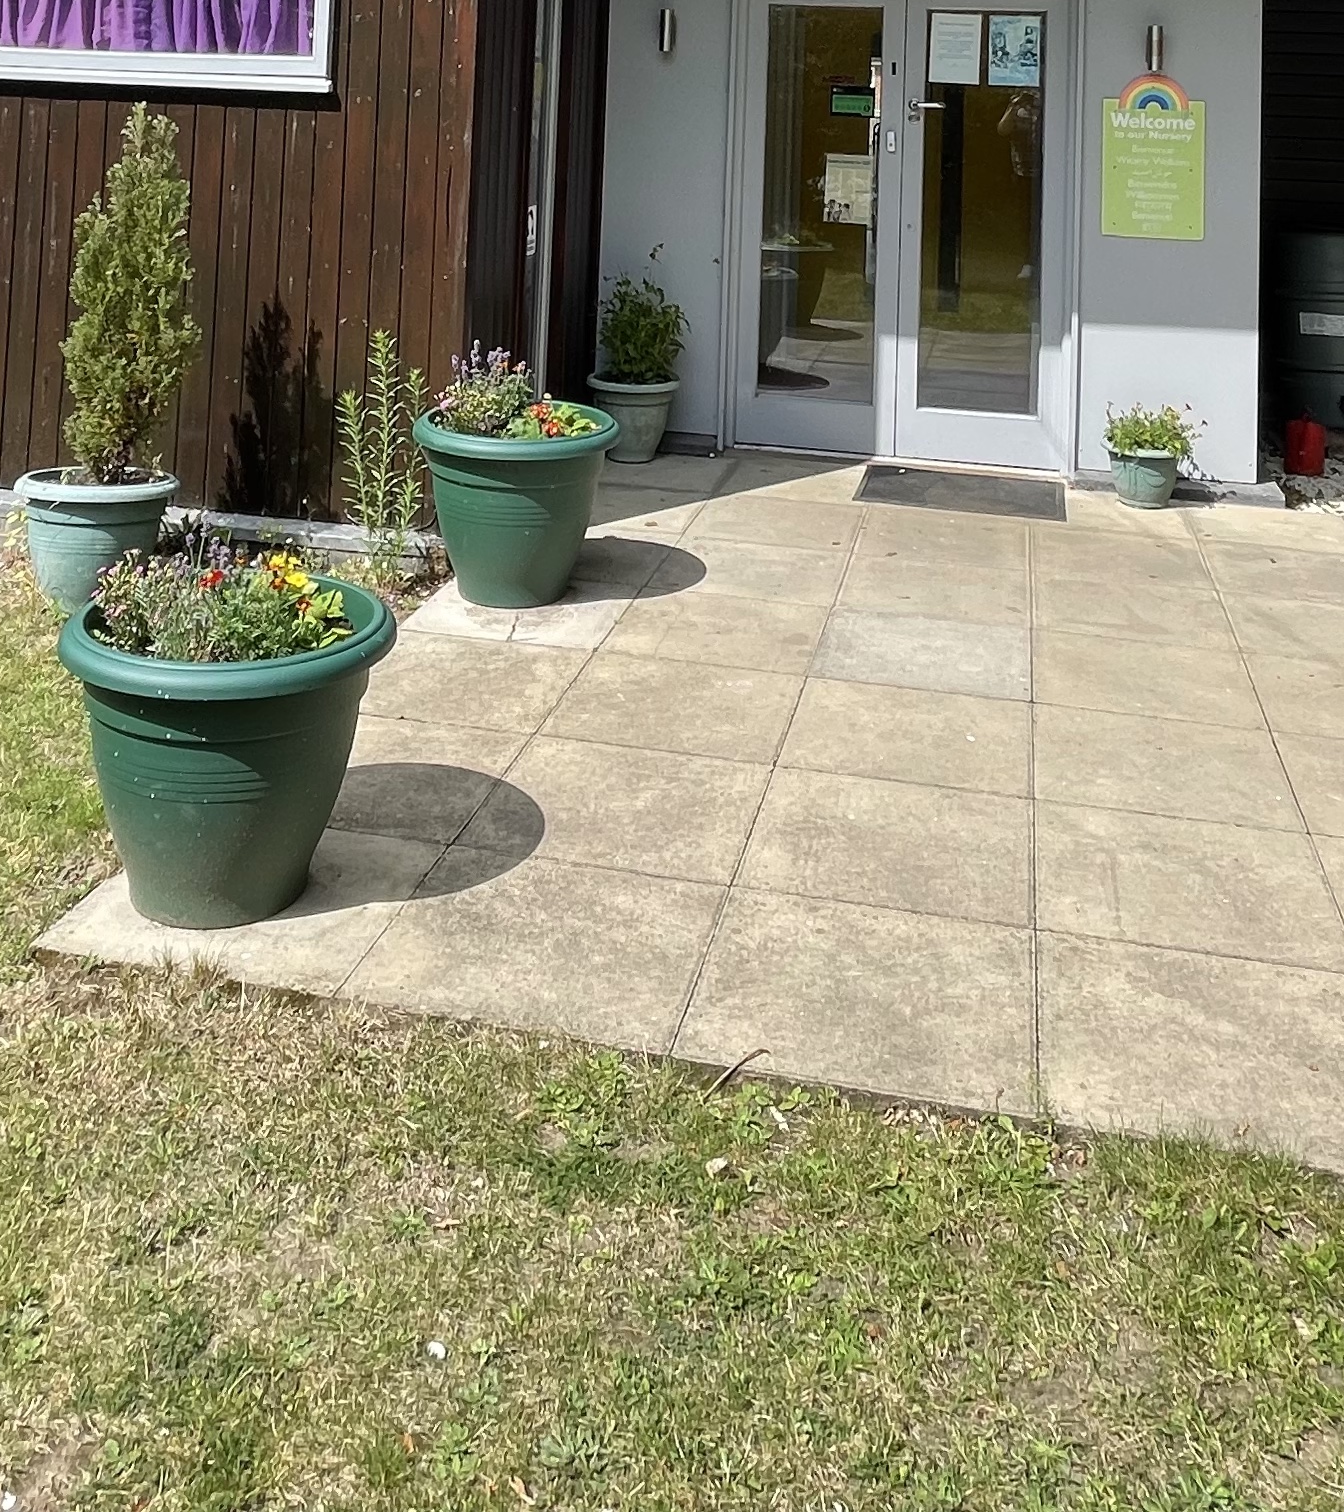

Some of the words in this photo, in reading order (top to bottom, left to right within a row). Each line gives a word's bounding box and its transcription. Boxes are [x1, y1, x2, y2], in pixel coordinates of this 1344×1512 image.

[1110, 112, 1196, 130] Welcome
[1114, 131, 1125, 139] to
[1149, 131, 1192, 143] Nursery
